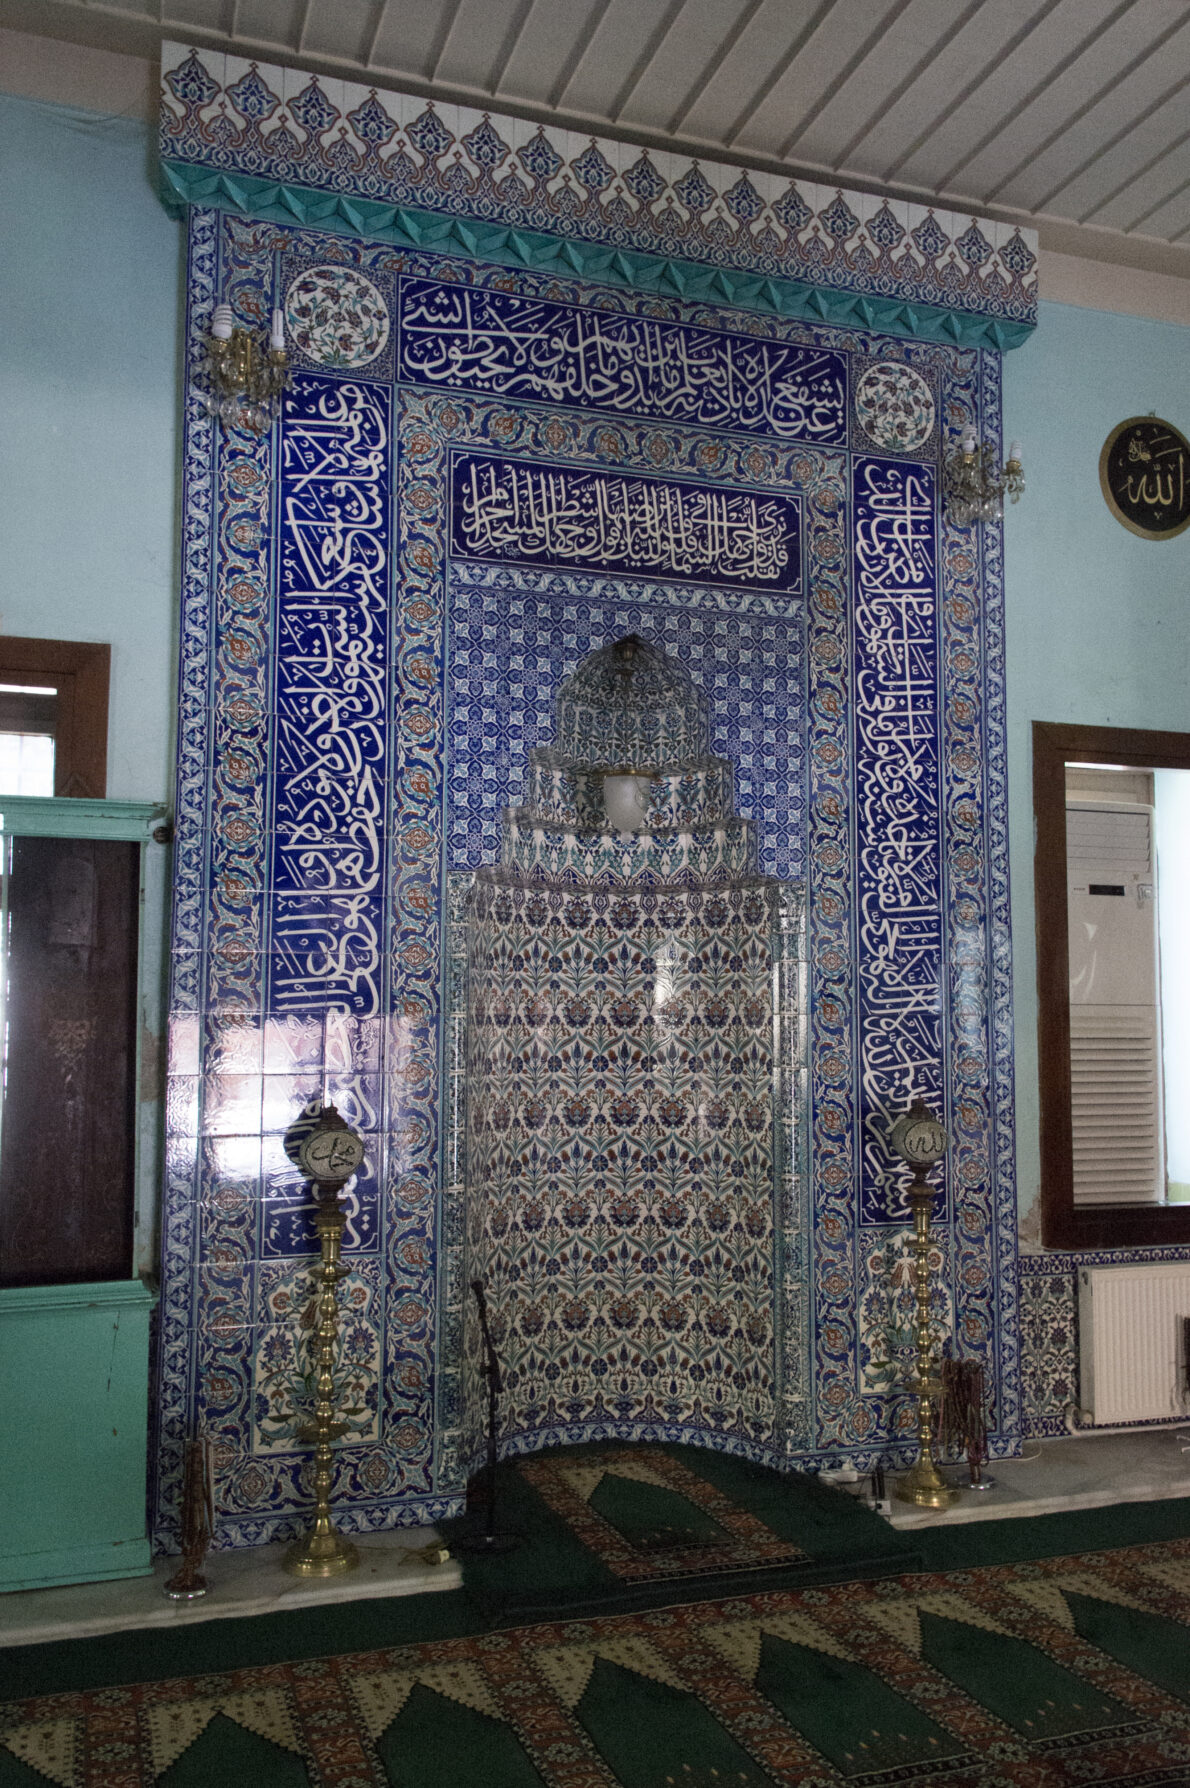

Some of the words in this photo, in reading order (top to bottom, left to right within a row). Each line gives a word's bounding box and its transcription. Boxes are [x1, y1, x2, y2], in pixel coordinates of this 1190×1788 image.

[493, 312, 619, 400] خلفهم
[772, 377, 845, 435] يشفع
[1123, 444, 1169, 492] الله
